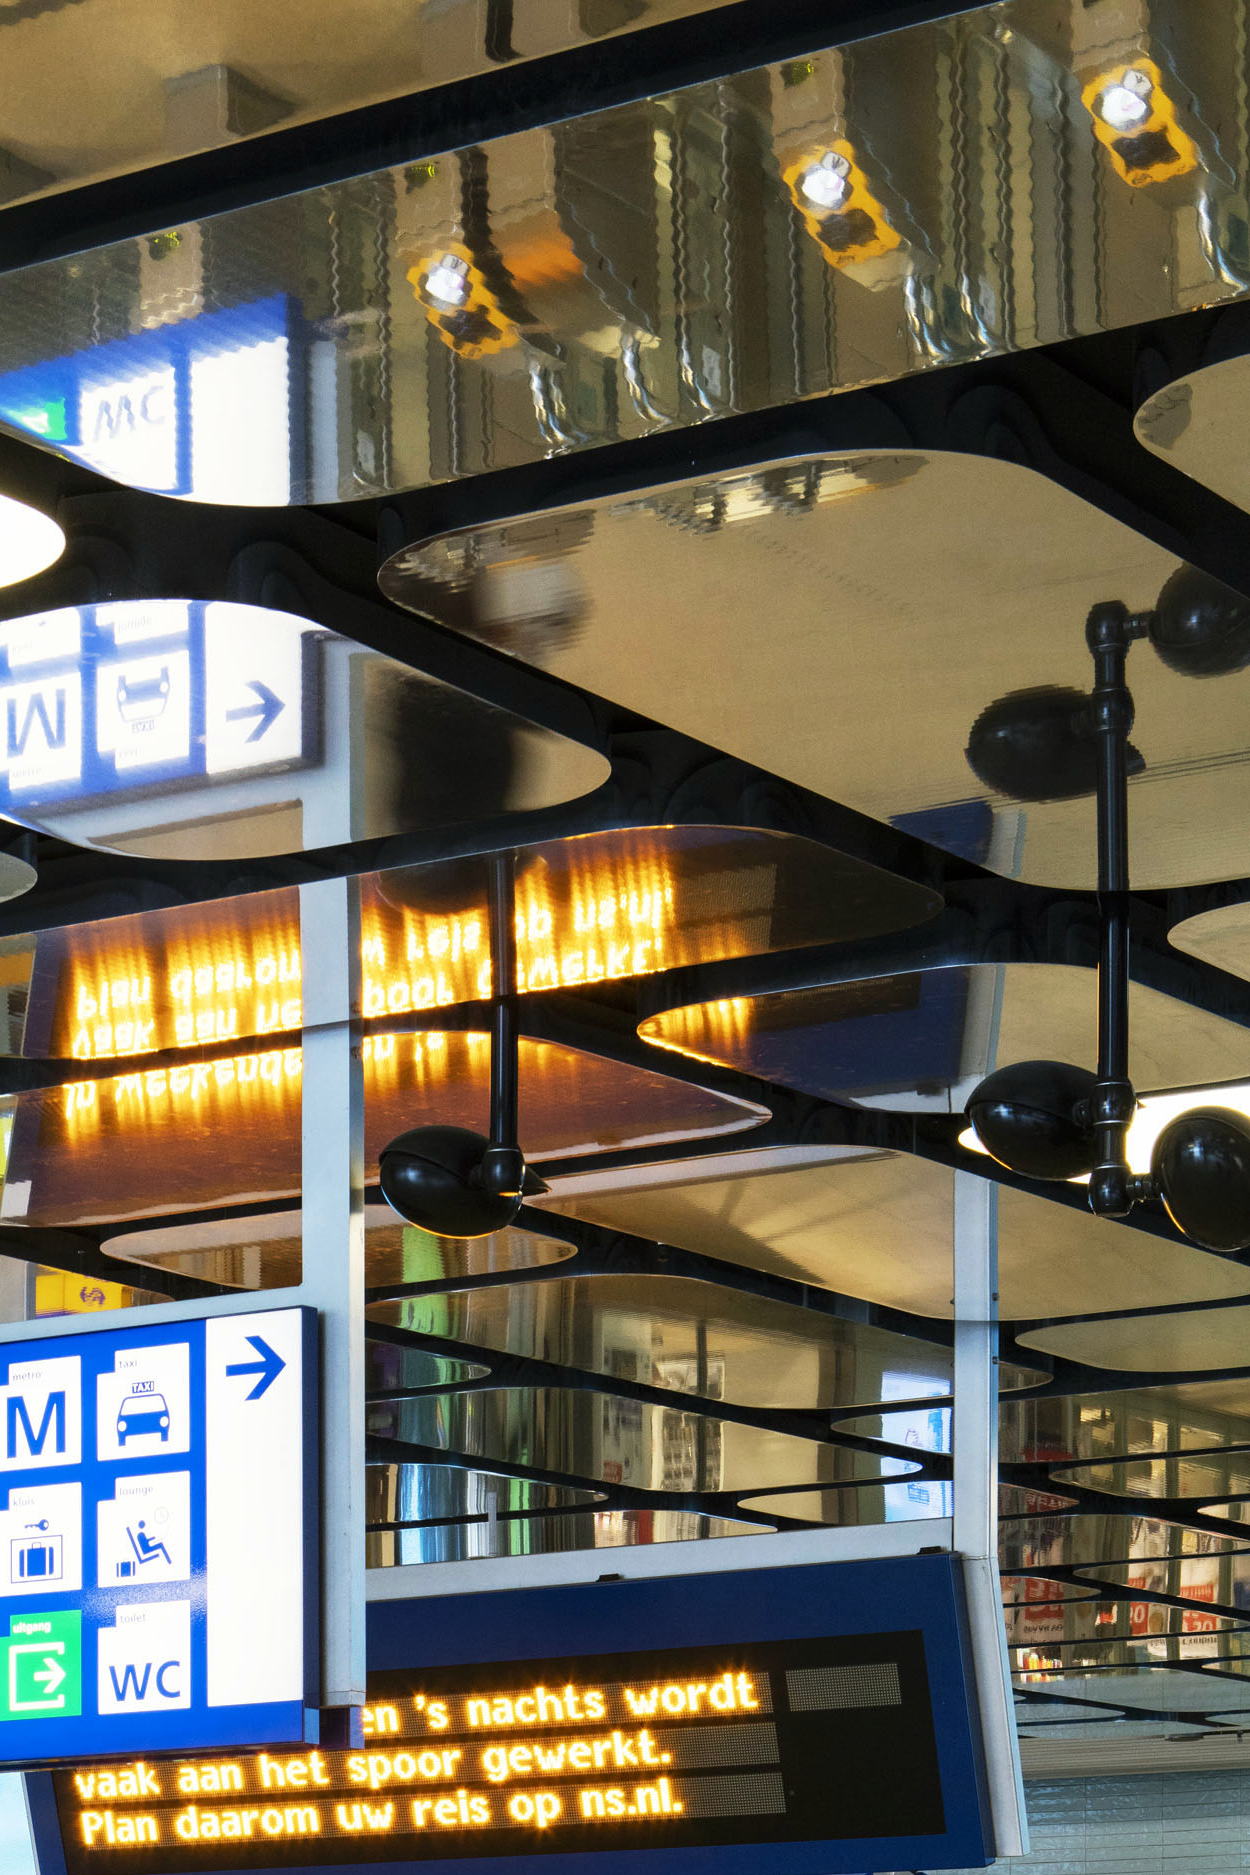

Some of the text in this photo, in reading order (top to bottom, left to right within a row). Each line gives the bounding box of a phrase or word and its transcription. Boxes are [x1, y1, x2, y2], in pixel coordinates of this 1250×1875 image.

[119, 1360, 137, 1369] taxi
[13, 1371, 41, 1382] metro
[133, 1382, 154, 1393] TAXI
[7, 1391, 66, 1458] M
[119, 1485, 154, 1497] lounge
[120, 1612, 147, 1624] toilet
[12, 1621, 51, 1636] uitgang
[109, 1660, 181, 1702] WC
[467, 1685, 606, 1728] nachts
[625, 1672, 759, 1717] wordt
[74, 1729, 673, 1800] vaak aan het spoor gewerkt.
[80, 1777, 685, 1846] Plan daarom uw reis op ns.nl.
